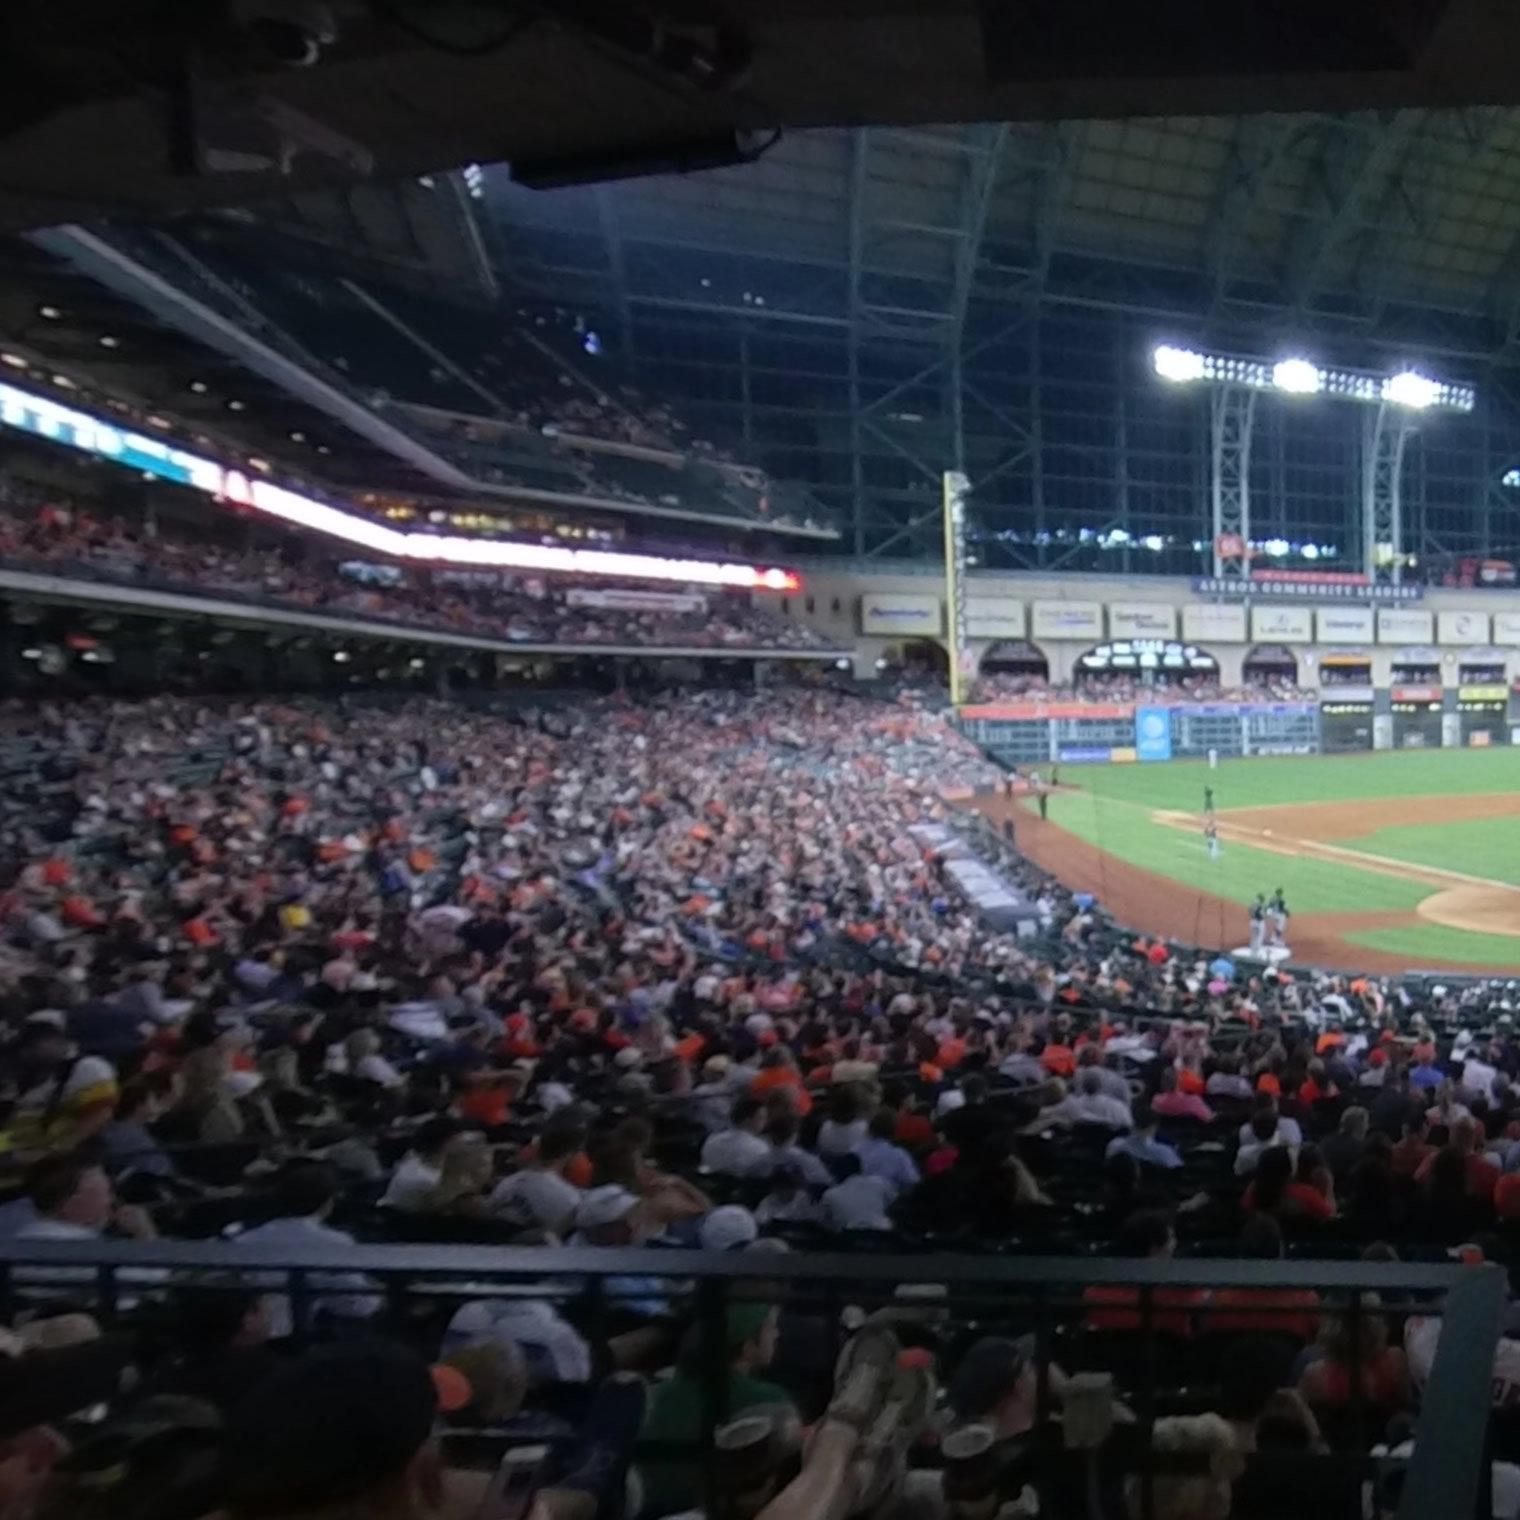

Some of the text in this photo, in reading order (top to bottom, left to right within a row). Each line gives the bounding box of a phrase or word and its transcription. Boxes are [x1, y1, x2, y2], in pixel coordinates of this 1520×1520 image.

[1200, 580, 1418, 599] ASTROS COMMUNITY LEADERS
